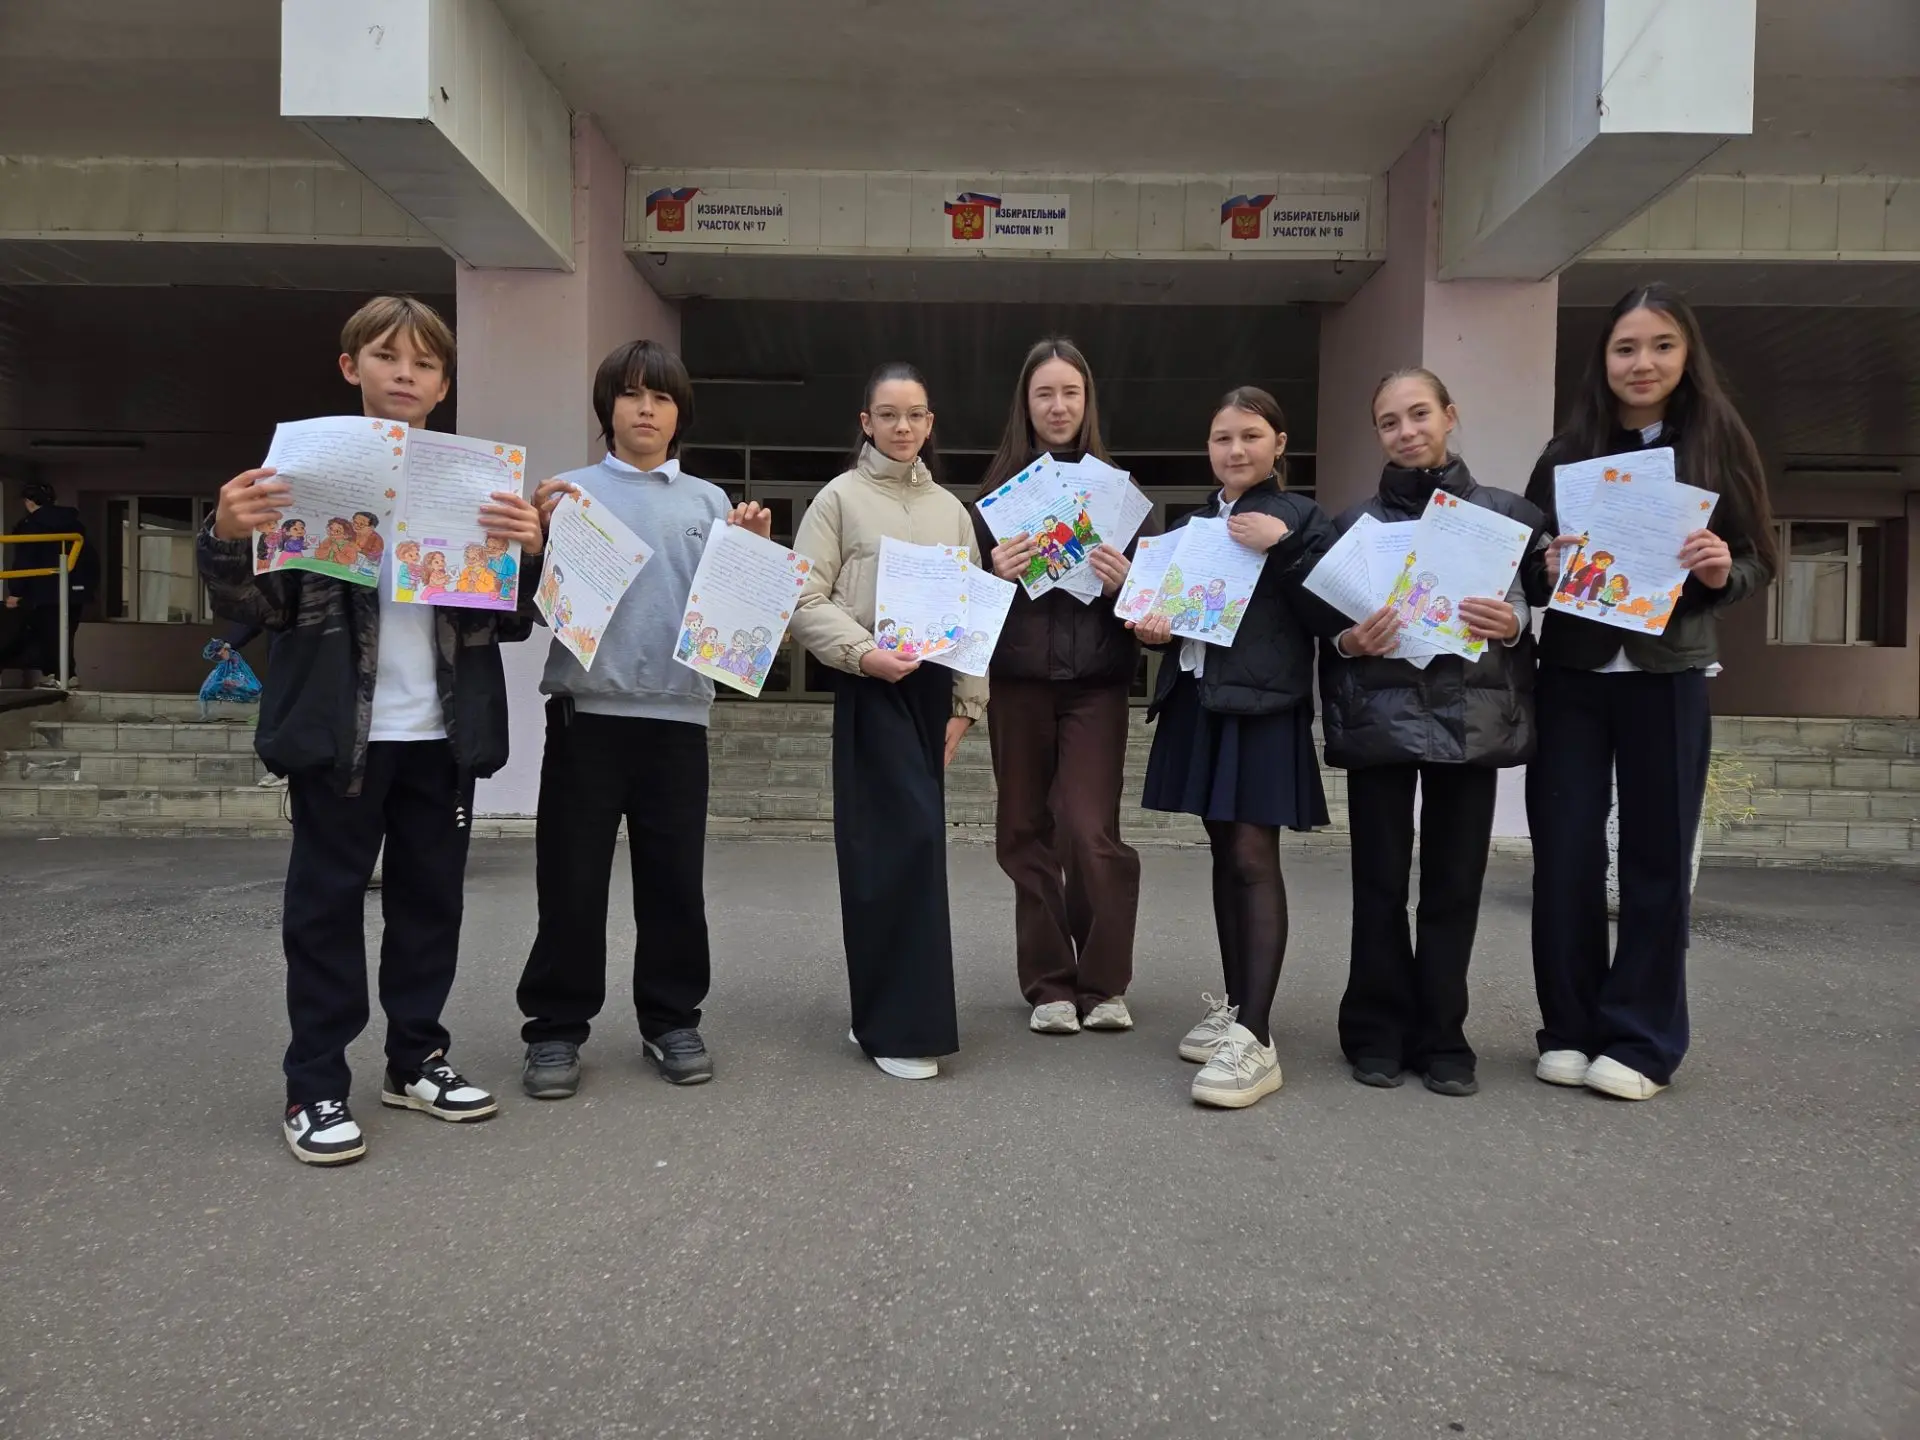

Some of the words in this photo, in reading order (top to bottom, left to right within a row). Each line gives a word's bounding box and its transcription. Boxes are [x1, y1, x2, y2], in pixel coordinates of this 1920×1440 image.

[697, 203, 783, 216] ИЗБИРАТЕЛЬНЫЙ
[995, 207, 1066, 220] ИЗБИРАТЕЛЬНЫЙ
[1273, 209, 1360, 222] ИЗБИРАТЕЛЬНЫЙ
[697, 220, 741, 231] УЧАСТОК
[743, 221, 755, 231] №
[757, 221, 766, 231] 17
[995, 224, 1031, 235] УЧАСТОК
[1033, 225, 1043, 235] №
[1044, 226, 1054, 236] 11
[1272, 227, 1317, 237] УЧАСТОК
[1319, 227, 1331, 237] №
[1333, 227, 1344, 237] 16
